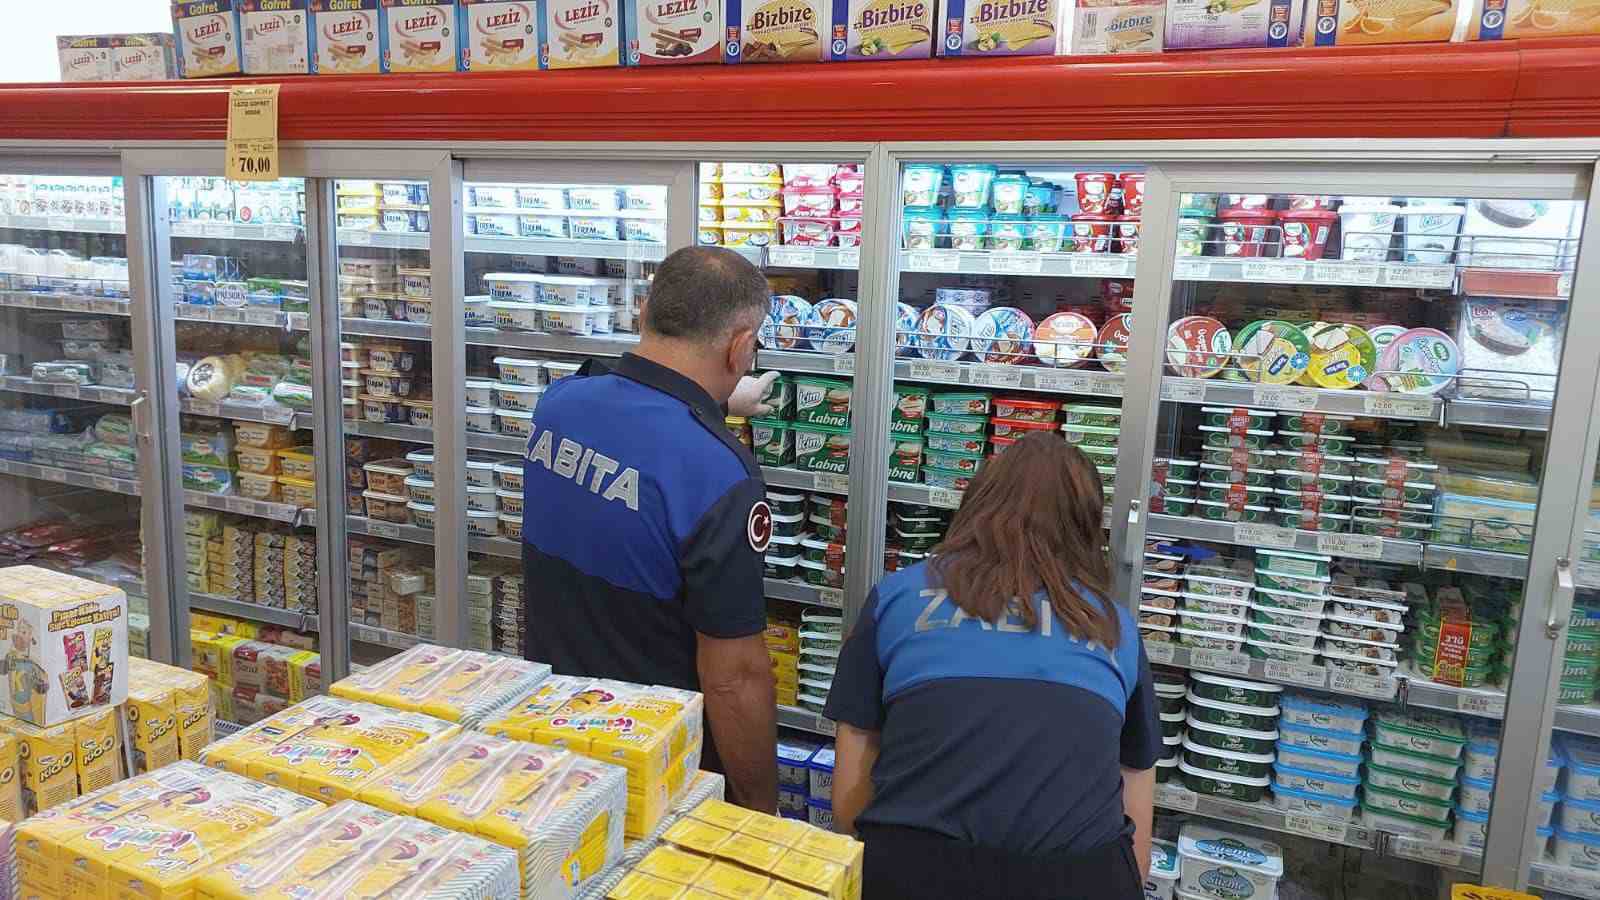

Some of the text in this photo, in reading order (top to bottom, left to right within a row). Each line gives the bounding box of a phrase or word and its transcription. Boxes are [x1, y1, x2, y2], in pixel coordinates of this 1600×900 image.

[404, 12, 439, 30] LEZİZ
[486, 8, 521, 28] LEZİZ
[565, 1, 601, 22] LEZİZ
[753, 6, 813, 31] Bizbize
[862, 2, 925, 29] Bizbize
[979, 0, 1048, 23] Bizbize
[194, 19, 221, 39] LEZİZ
[332, 16, 364, 34] LEZİZ
[239, 157, 271, 174] 70,00
[808, 411, 846, 426] Labne
[807, 457, 846, 472] Labne
[914, 588, 1120, 668] ZABI
